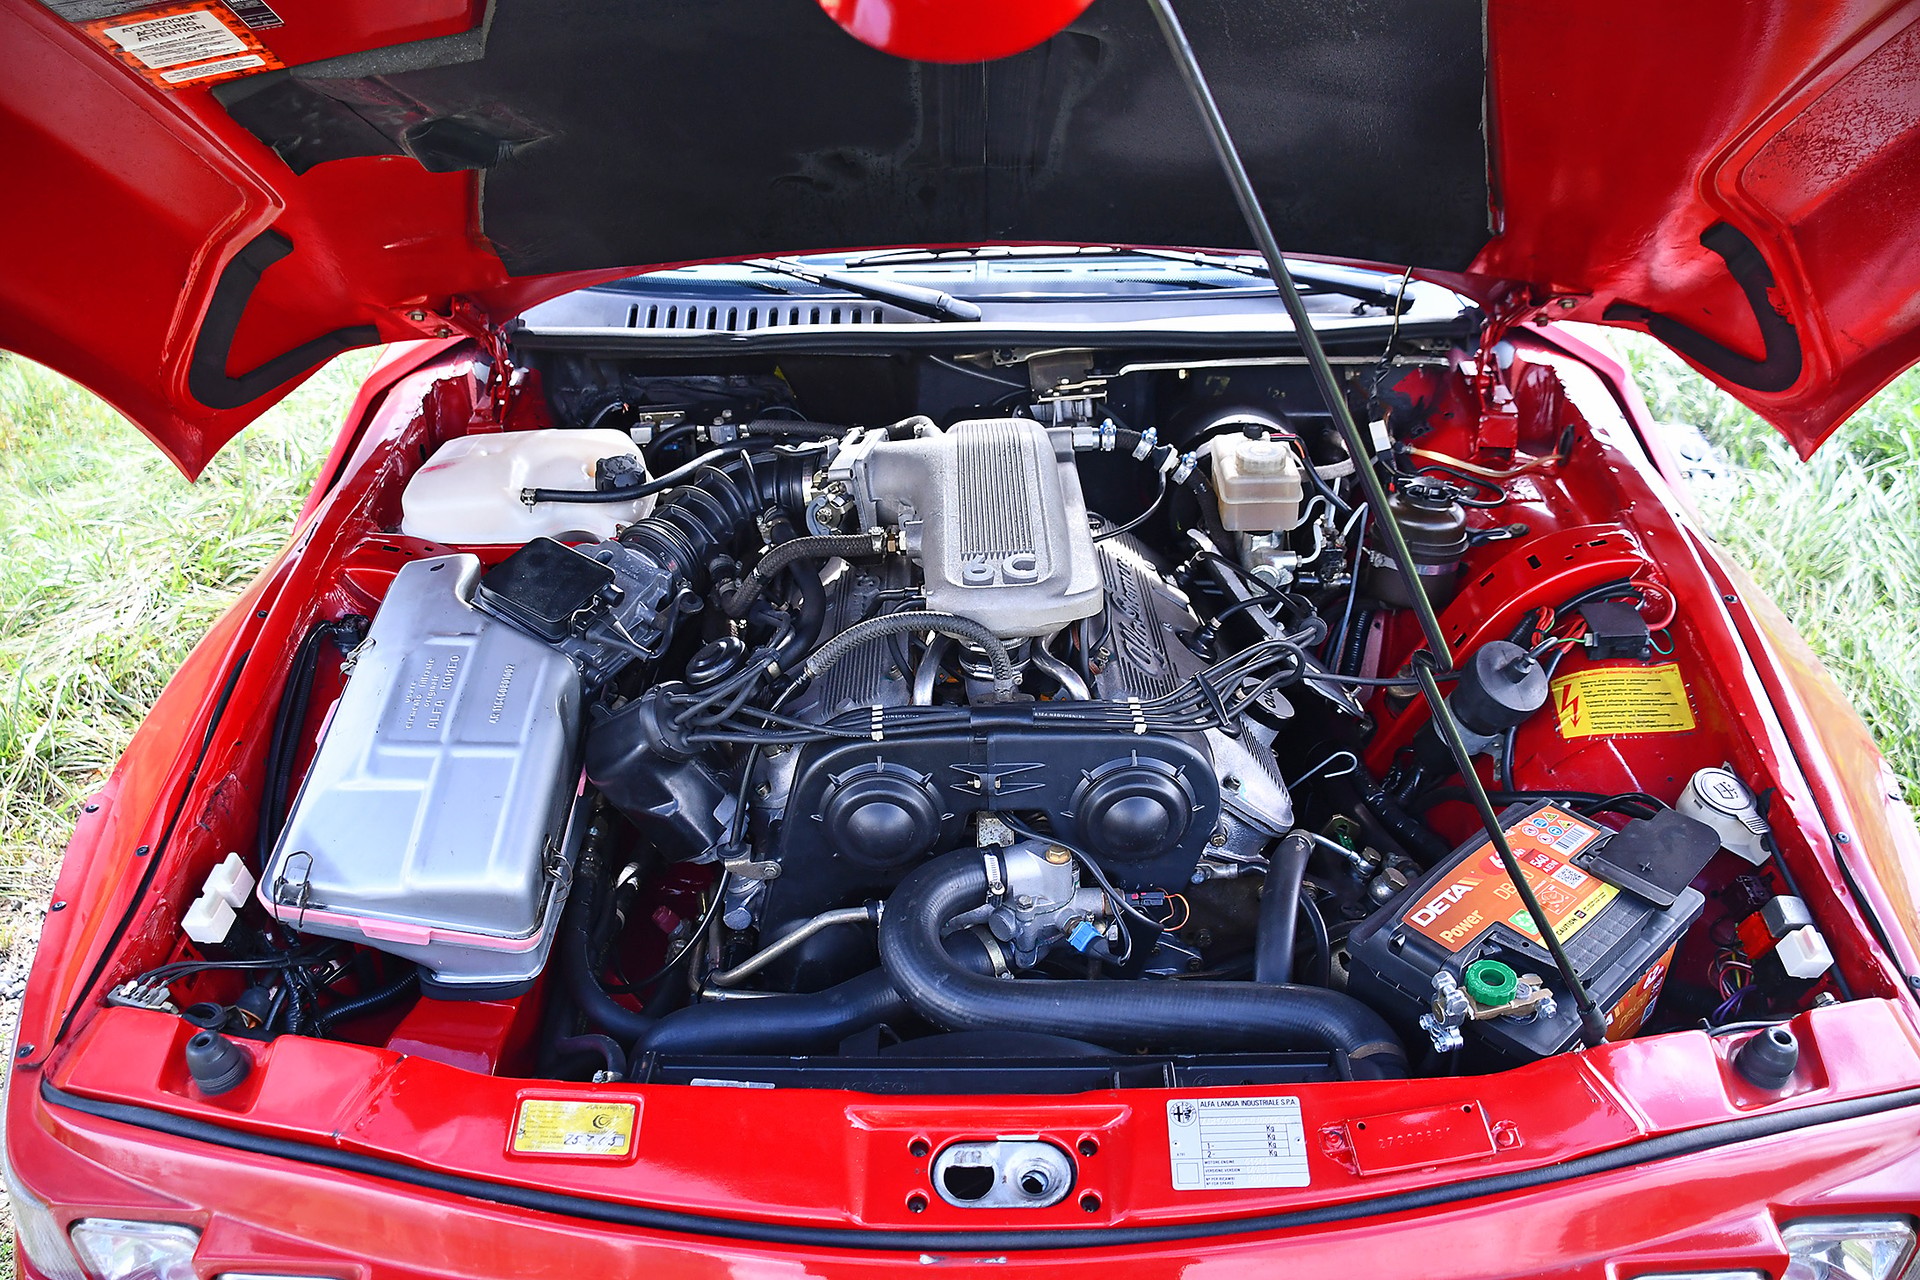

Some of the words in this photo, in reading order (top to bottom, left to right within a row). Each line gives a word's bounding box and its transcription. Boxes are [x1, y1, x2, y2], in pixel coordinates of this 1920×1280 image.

[121, 14, 200, 33] ATTENZIONE
[136, 20, 197, 37] ACHTUNG
[137, 24, 206, 42] ATTENTION
[426, 699, 446, 730] ALFA
[440, 654, 461, 691] ROMEO
[1529, 854, 1550, 868] 540
[1410, 883, 1474, 928] DETA
[1439, 909, 1484, 944] Power
[1556, 917, 1578, 936] CAUTION
[1199, 1100, 1216, 1108] ALFA
[1241, 1098, 1279, 1107] INDUSTRIALE
[1266, 1124, 1275, 1133] Kg
[1267, 1132, 1276, 1141] Kg
[1267, 1141, 1277, 1149] Kg
[1268, 1149, 1278, 1158] Kg
